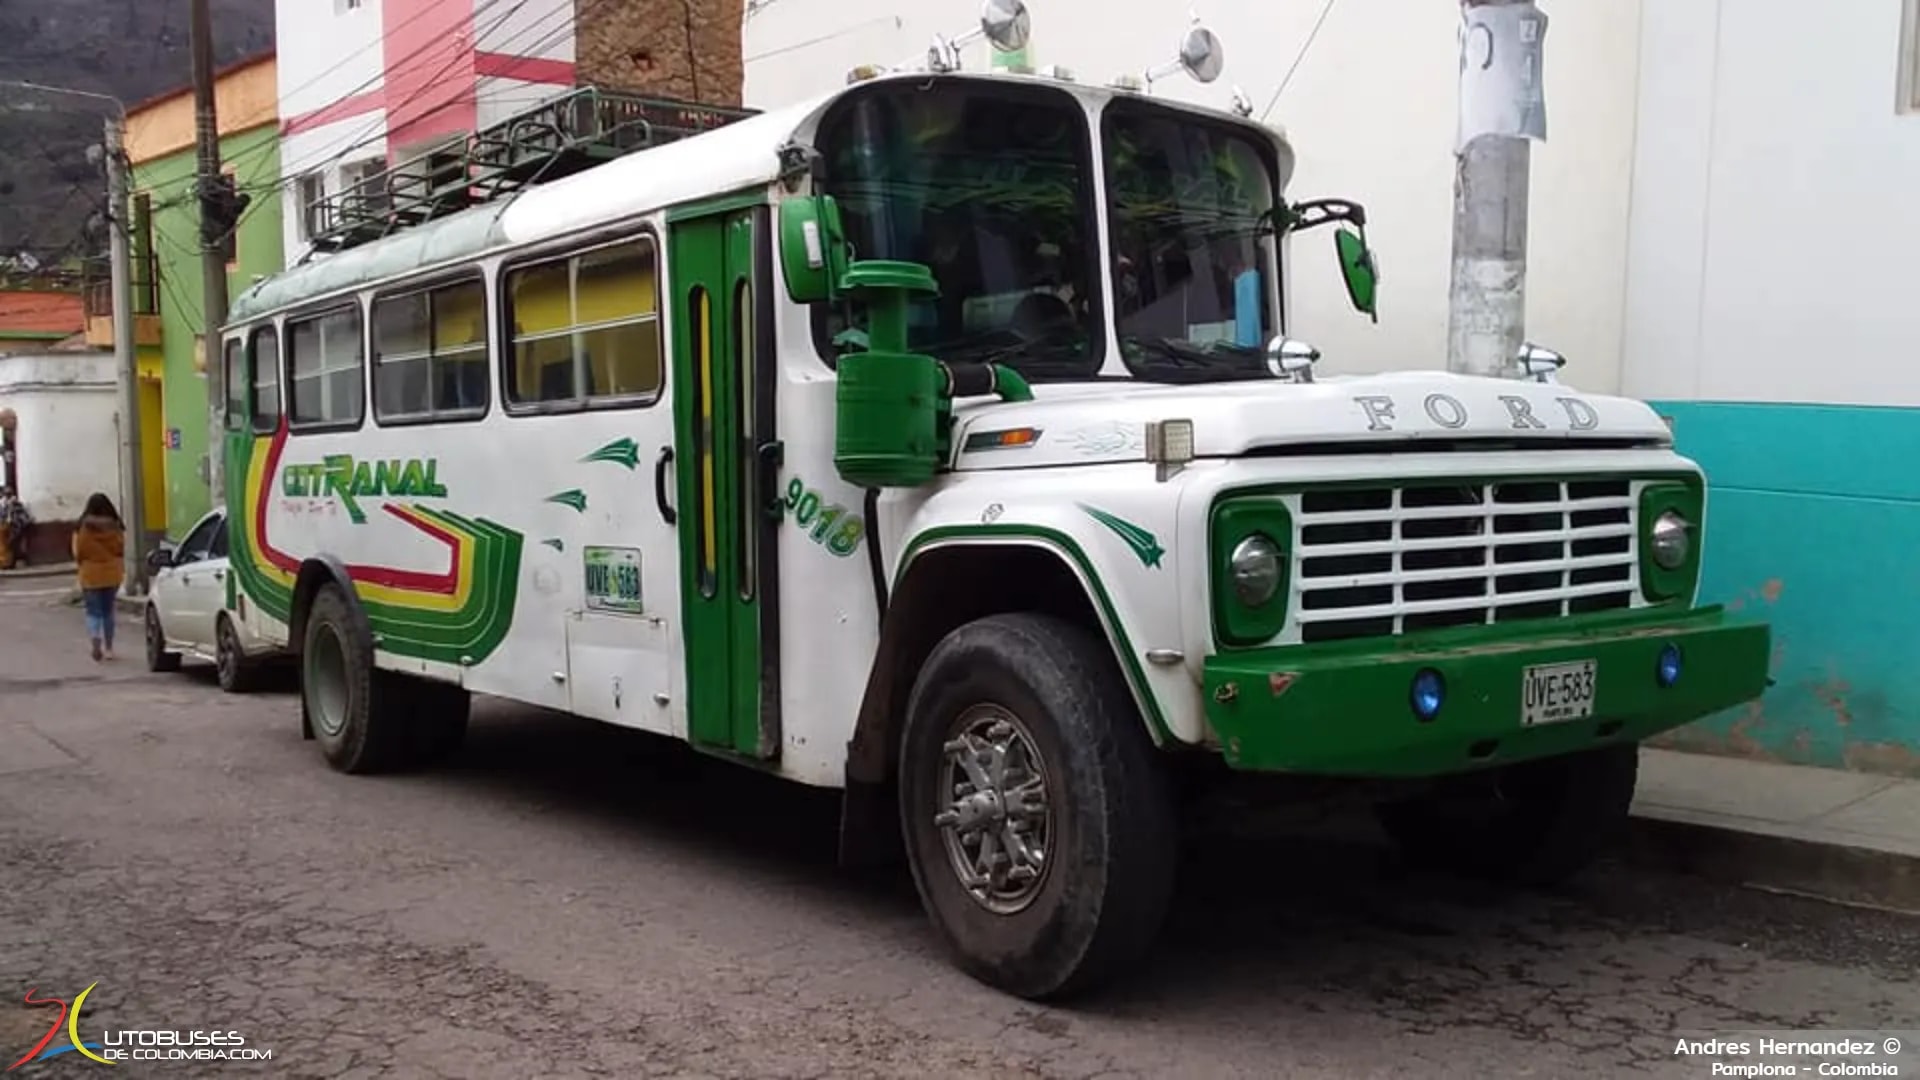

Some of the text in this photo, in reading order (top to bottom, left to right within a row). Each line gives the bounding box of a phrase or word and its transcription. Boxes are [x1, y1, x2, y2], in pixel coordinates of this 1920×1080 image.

[1353, 393, 1599, 431] FORD
[282, 453, 448, 524] COTRANAL
[785, 477, 863, 556] 9018
